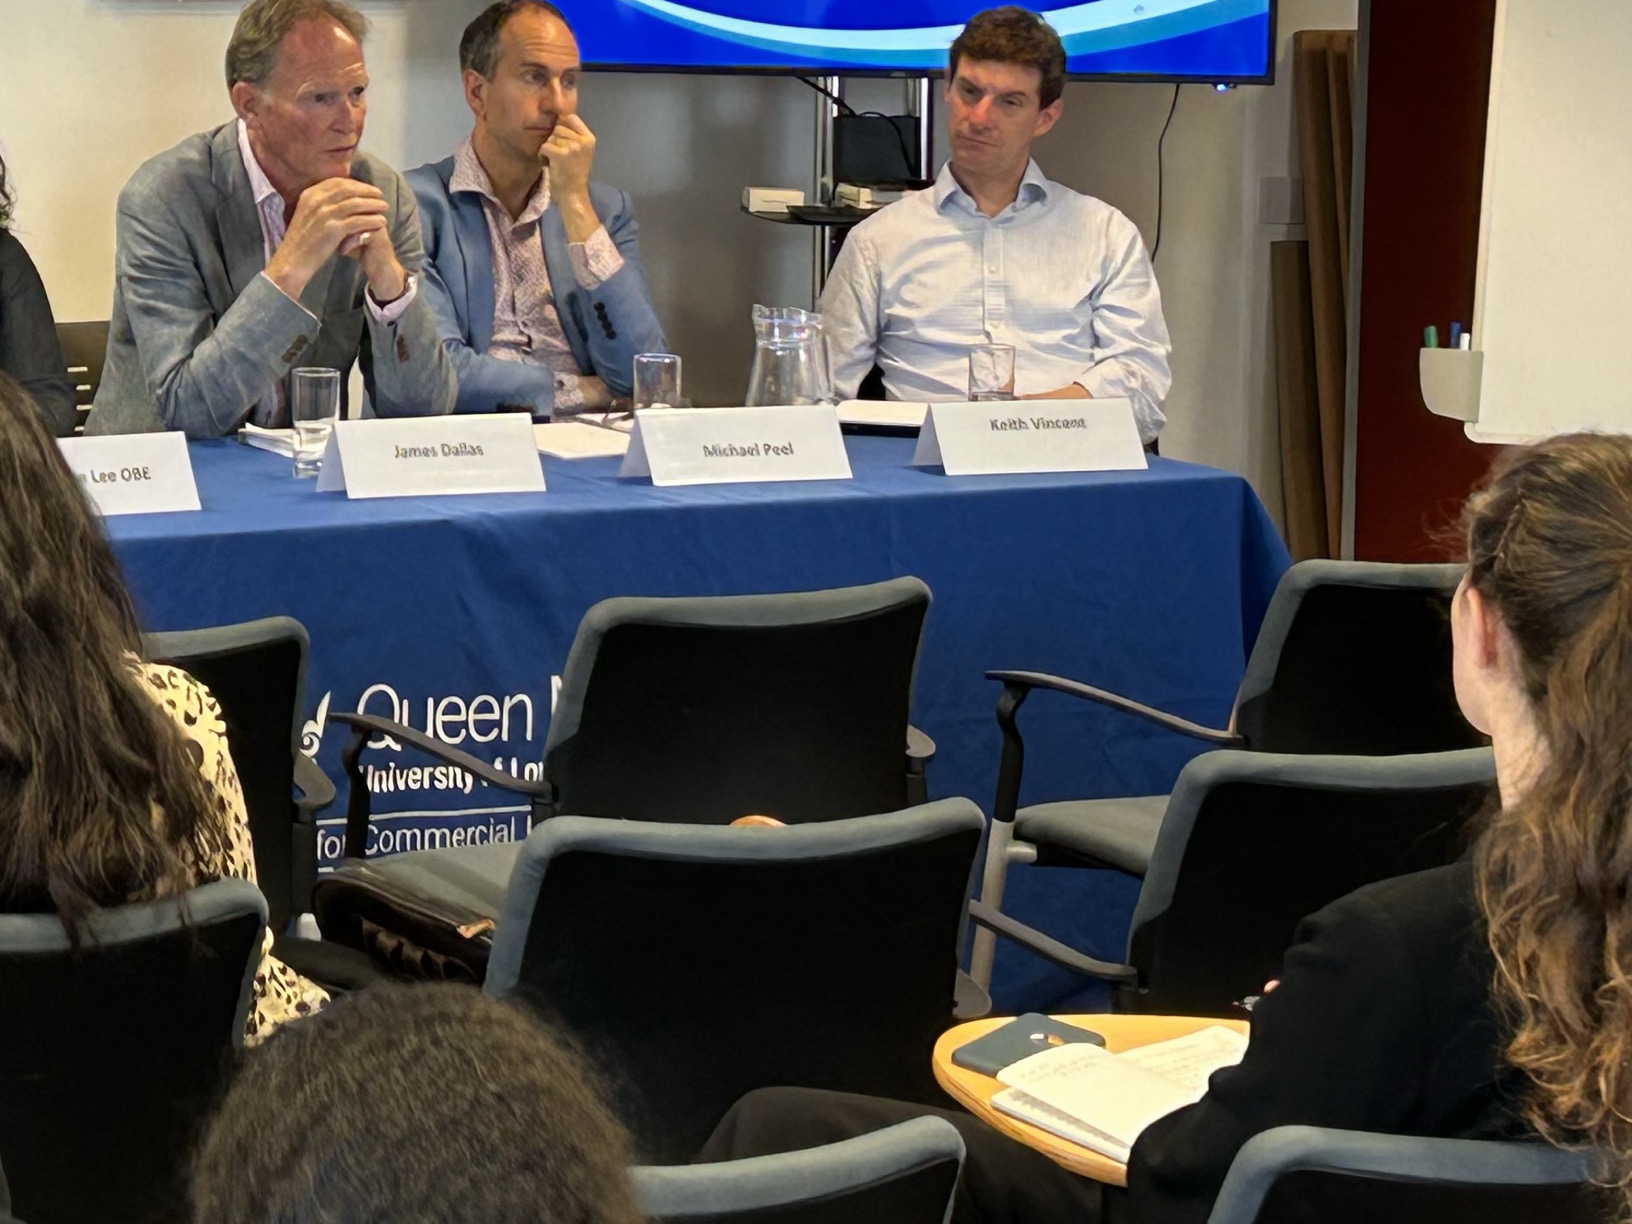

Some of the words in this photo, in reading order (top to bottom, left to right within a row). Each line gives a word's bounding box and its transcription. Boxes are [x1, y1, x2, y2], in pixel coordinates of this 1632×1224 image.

[989, 418, 1029, 431] Keith
[1030, 417, 1087, 430] Vincent
[395, 445, 438, 458] James
[441, 443, 484, 456] Dallas
[703, 443, 760, 457] Michael
[763, 441, 794, 456] Peel
[90, 469, 117, 483] Lee
[121, 467, 151, 482] OBE
[356, 683, 533, 751] Queen
[363, 817, 517, 856] Commercial
